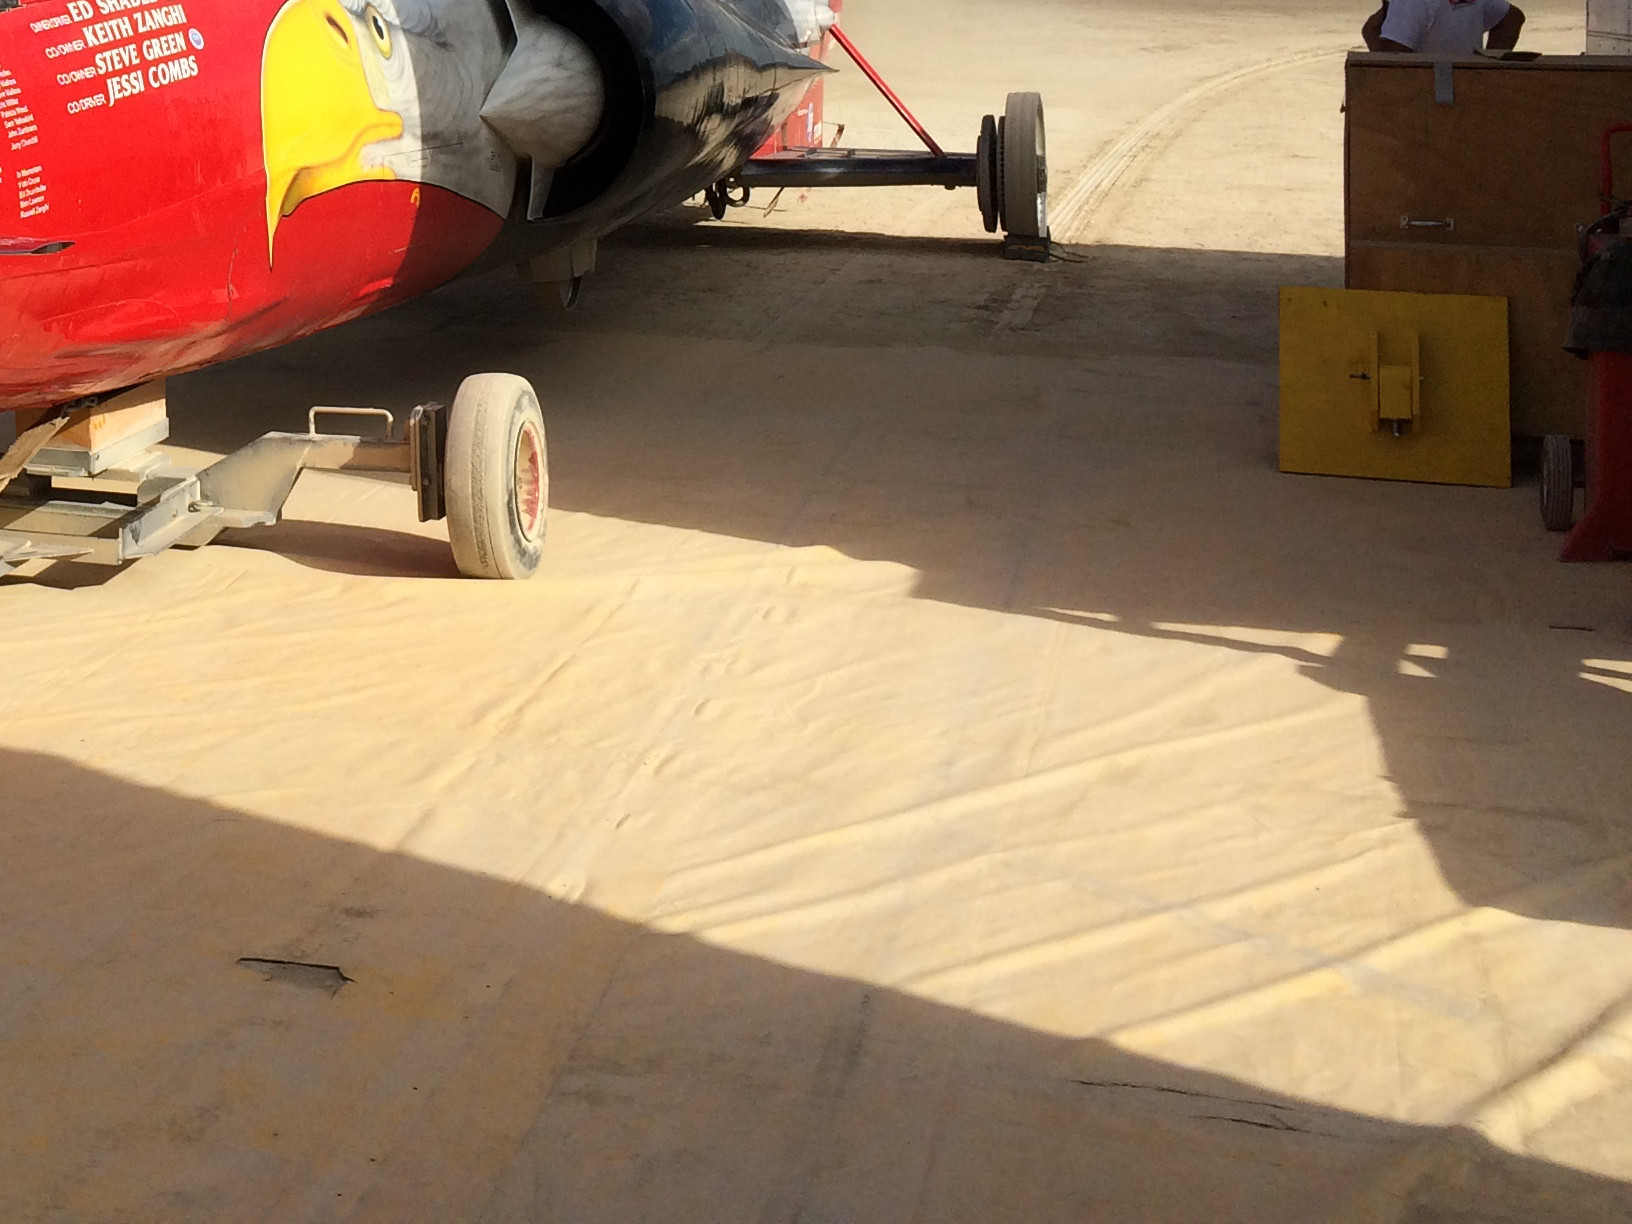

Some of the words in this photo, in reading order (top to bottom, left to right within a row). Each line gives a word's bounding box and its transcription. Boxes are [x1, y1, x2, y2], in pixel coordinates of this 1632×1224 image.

[44, 39, 87, 59] CO/OWNER
[81, 16, 134, 48] KEITH
[133, 4, 187, 33] ZANGHI
[66, 0, 94, 23] ED
[56, 66, 98, 86] CO/OWNER
[94, 43, 140, 75] STEVE
[142, 31, 187, 61] GREEN
[66, 93, 107, 114] CO/DRIVER
[106, 70, 145, 107] JESSI
[148, 55, 199, 88] COMBS
